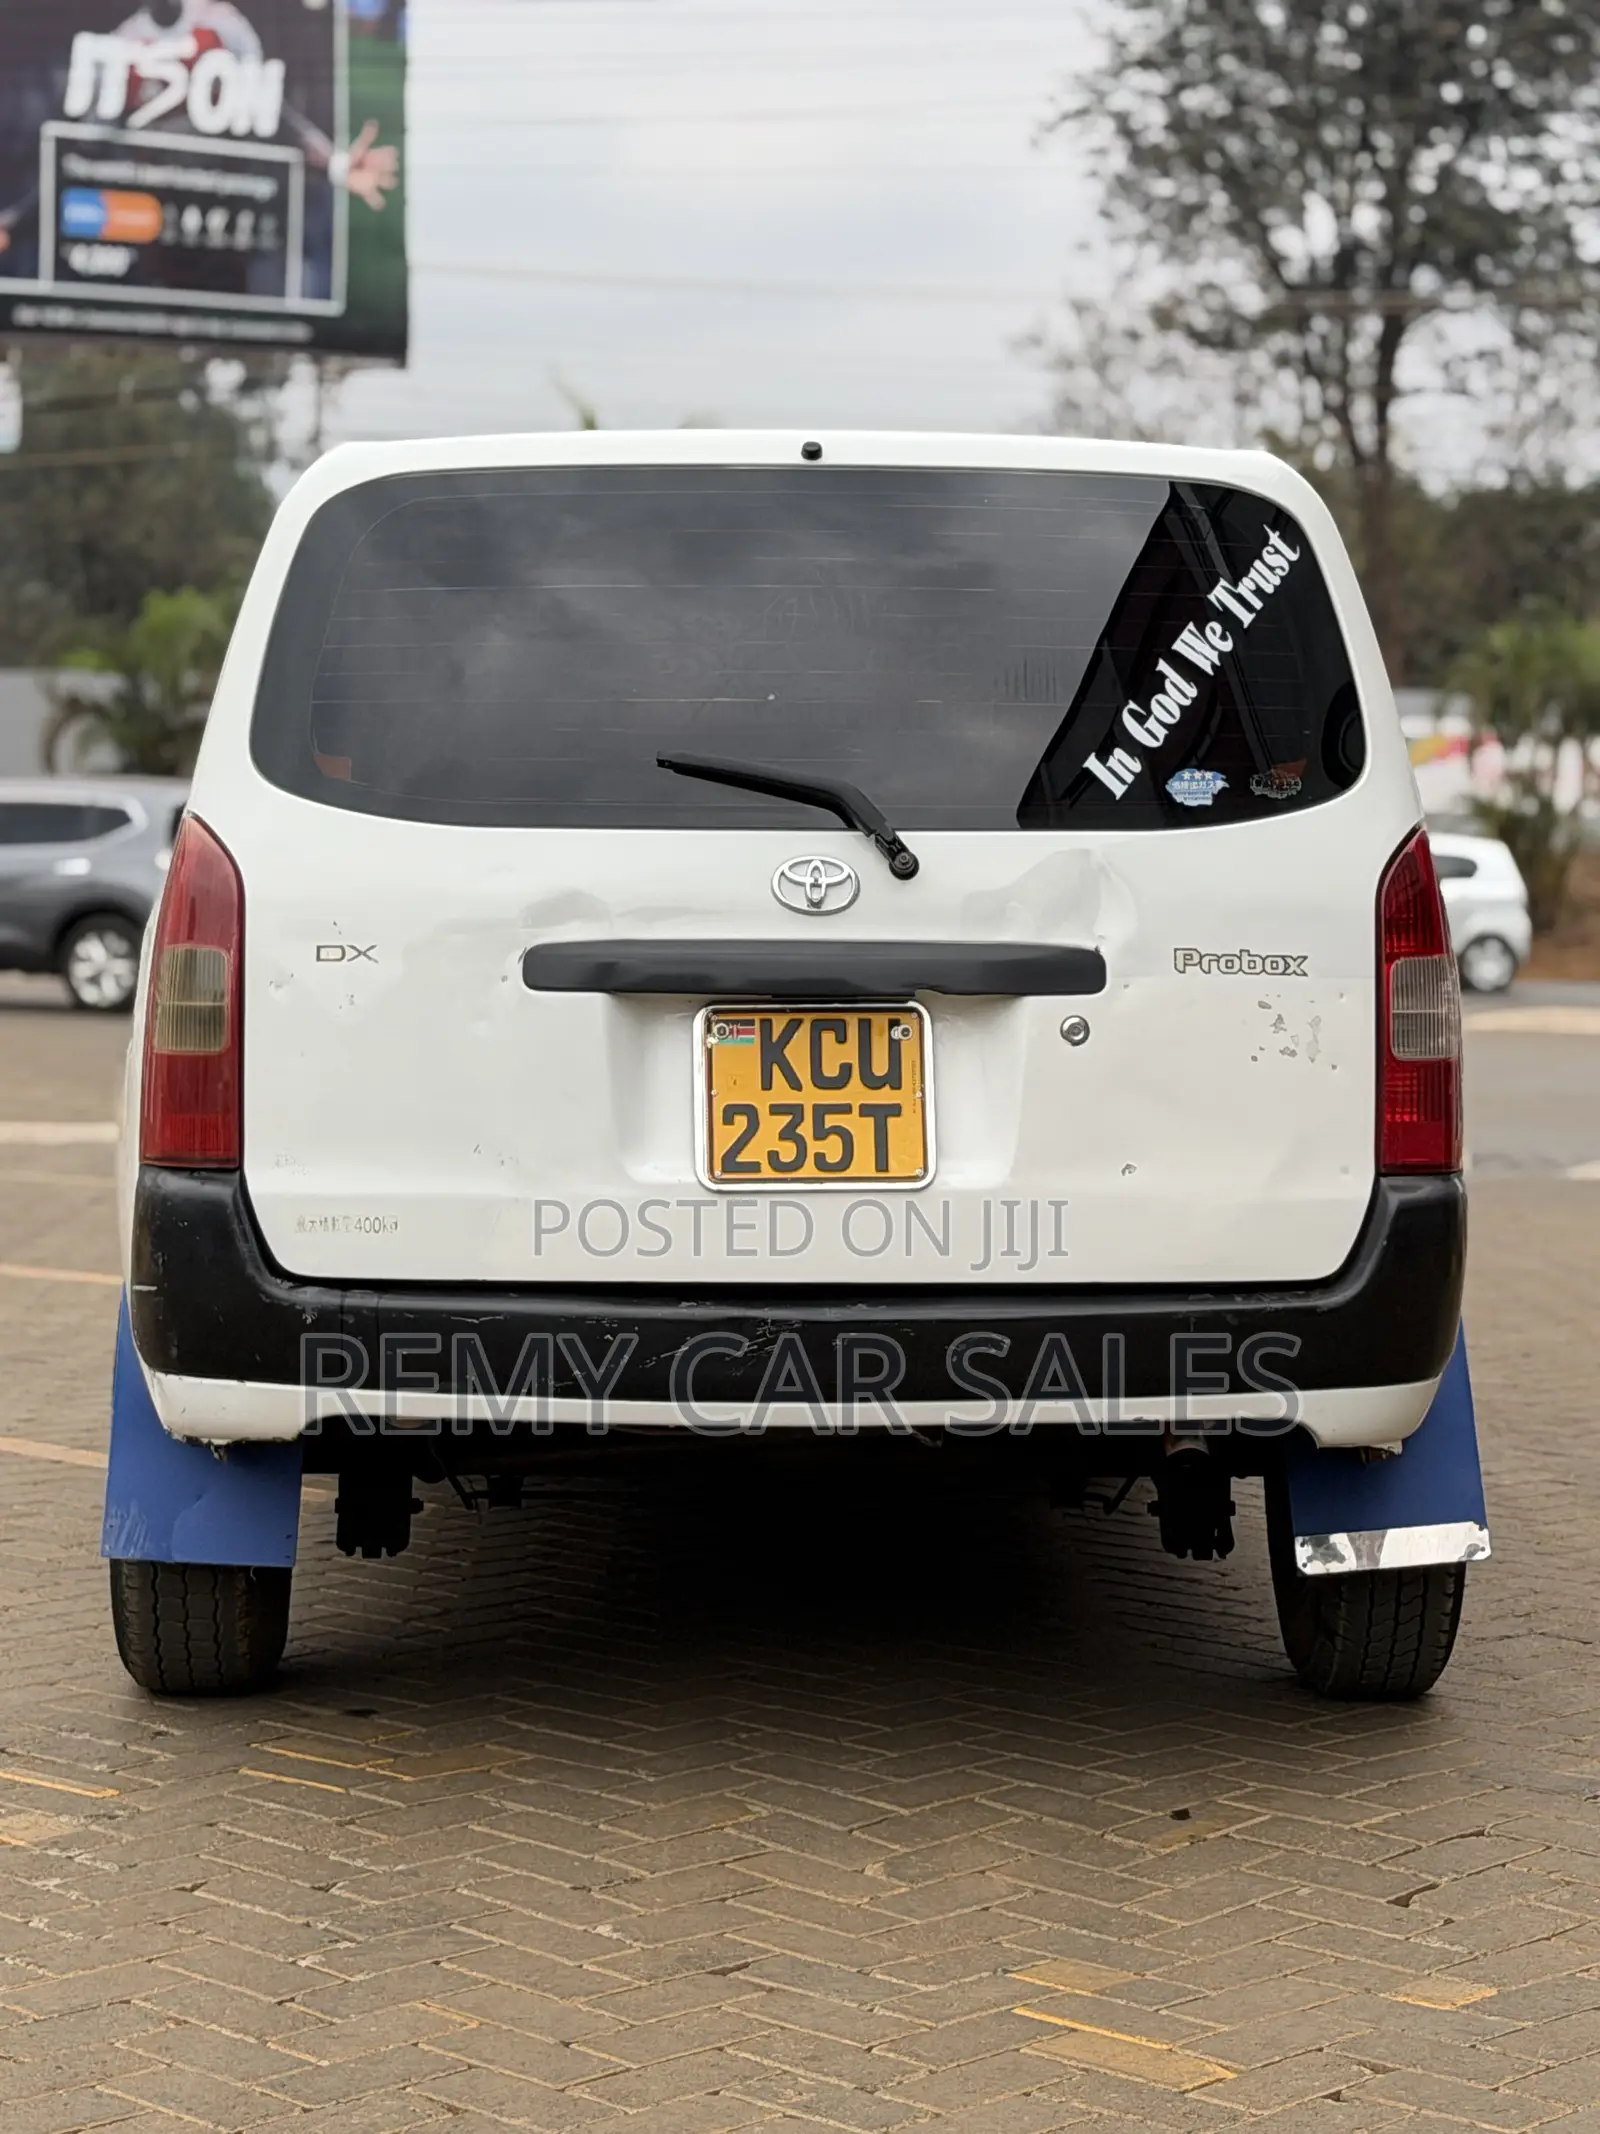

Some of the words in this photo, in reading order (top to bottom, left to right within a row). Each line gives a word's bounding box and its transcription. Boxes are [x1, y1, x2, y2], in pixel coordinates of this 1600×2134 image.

[1082, 747, 1142, 800] In
[1121, 657, 1198, 748] God
[1171, 621, 1234, 676] We
[1207, 524, 1300, 629] Trust
[316, 944, 379, 963] DX
[1174, 948, 1308, 977] Probox
[758, 1018, 903, 1092] KCU
[720, 1103, 903, 1174] 235T
